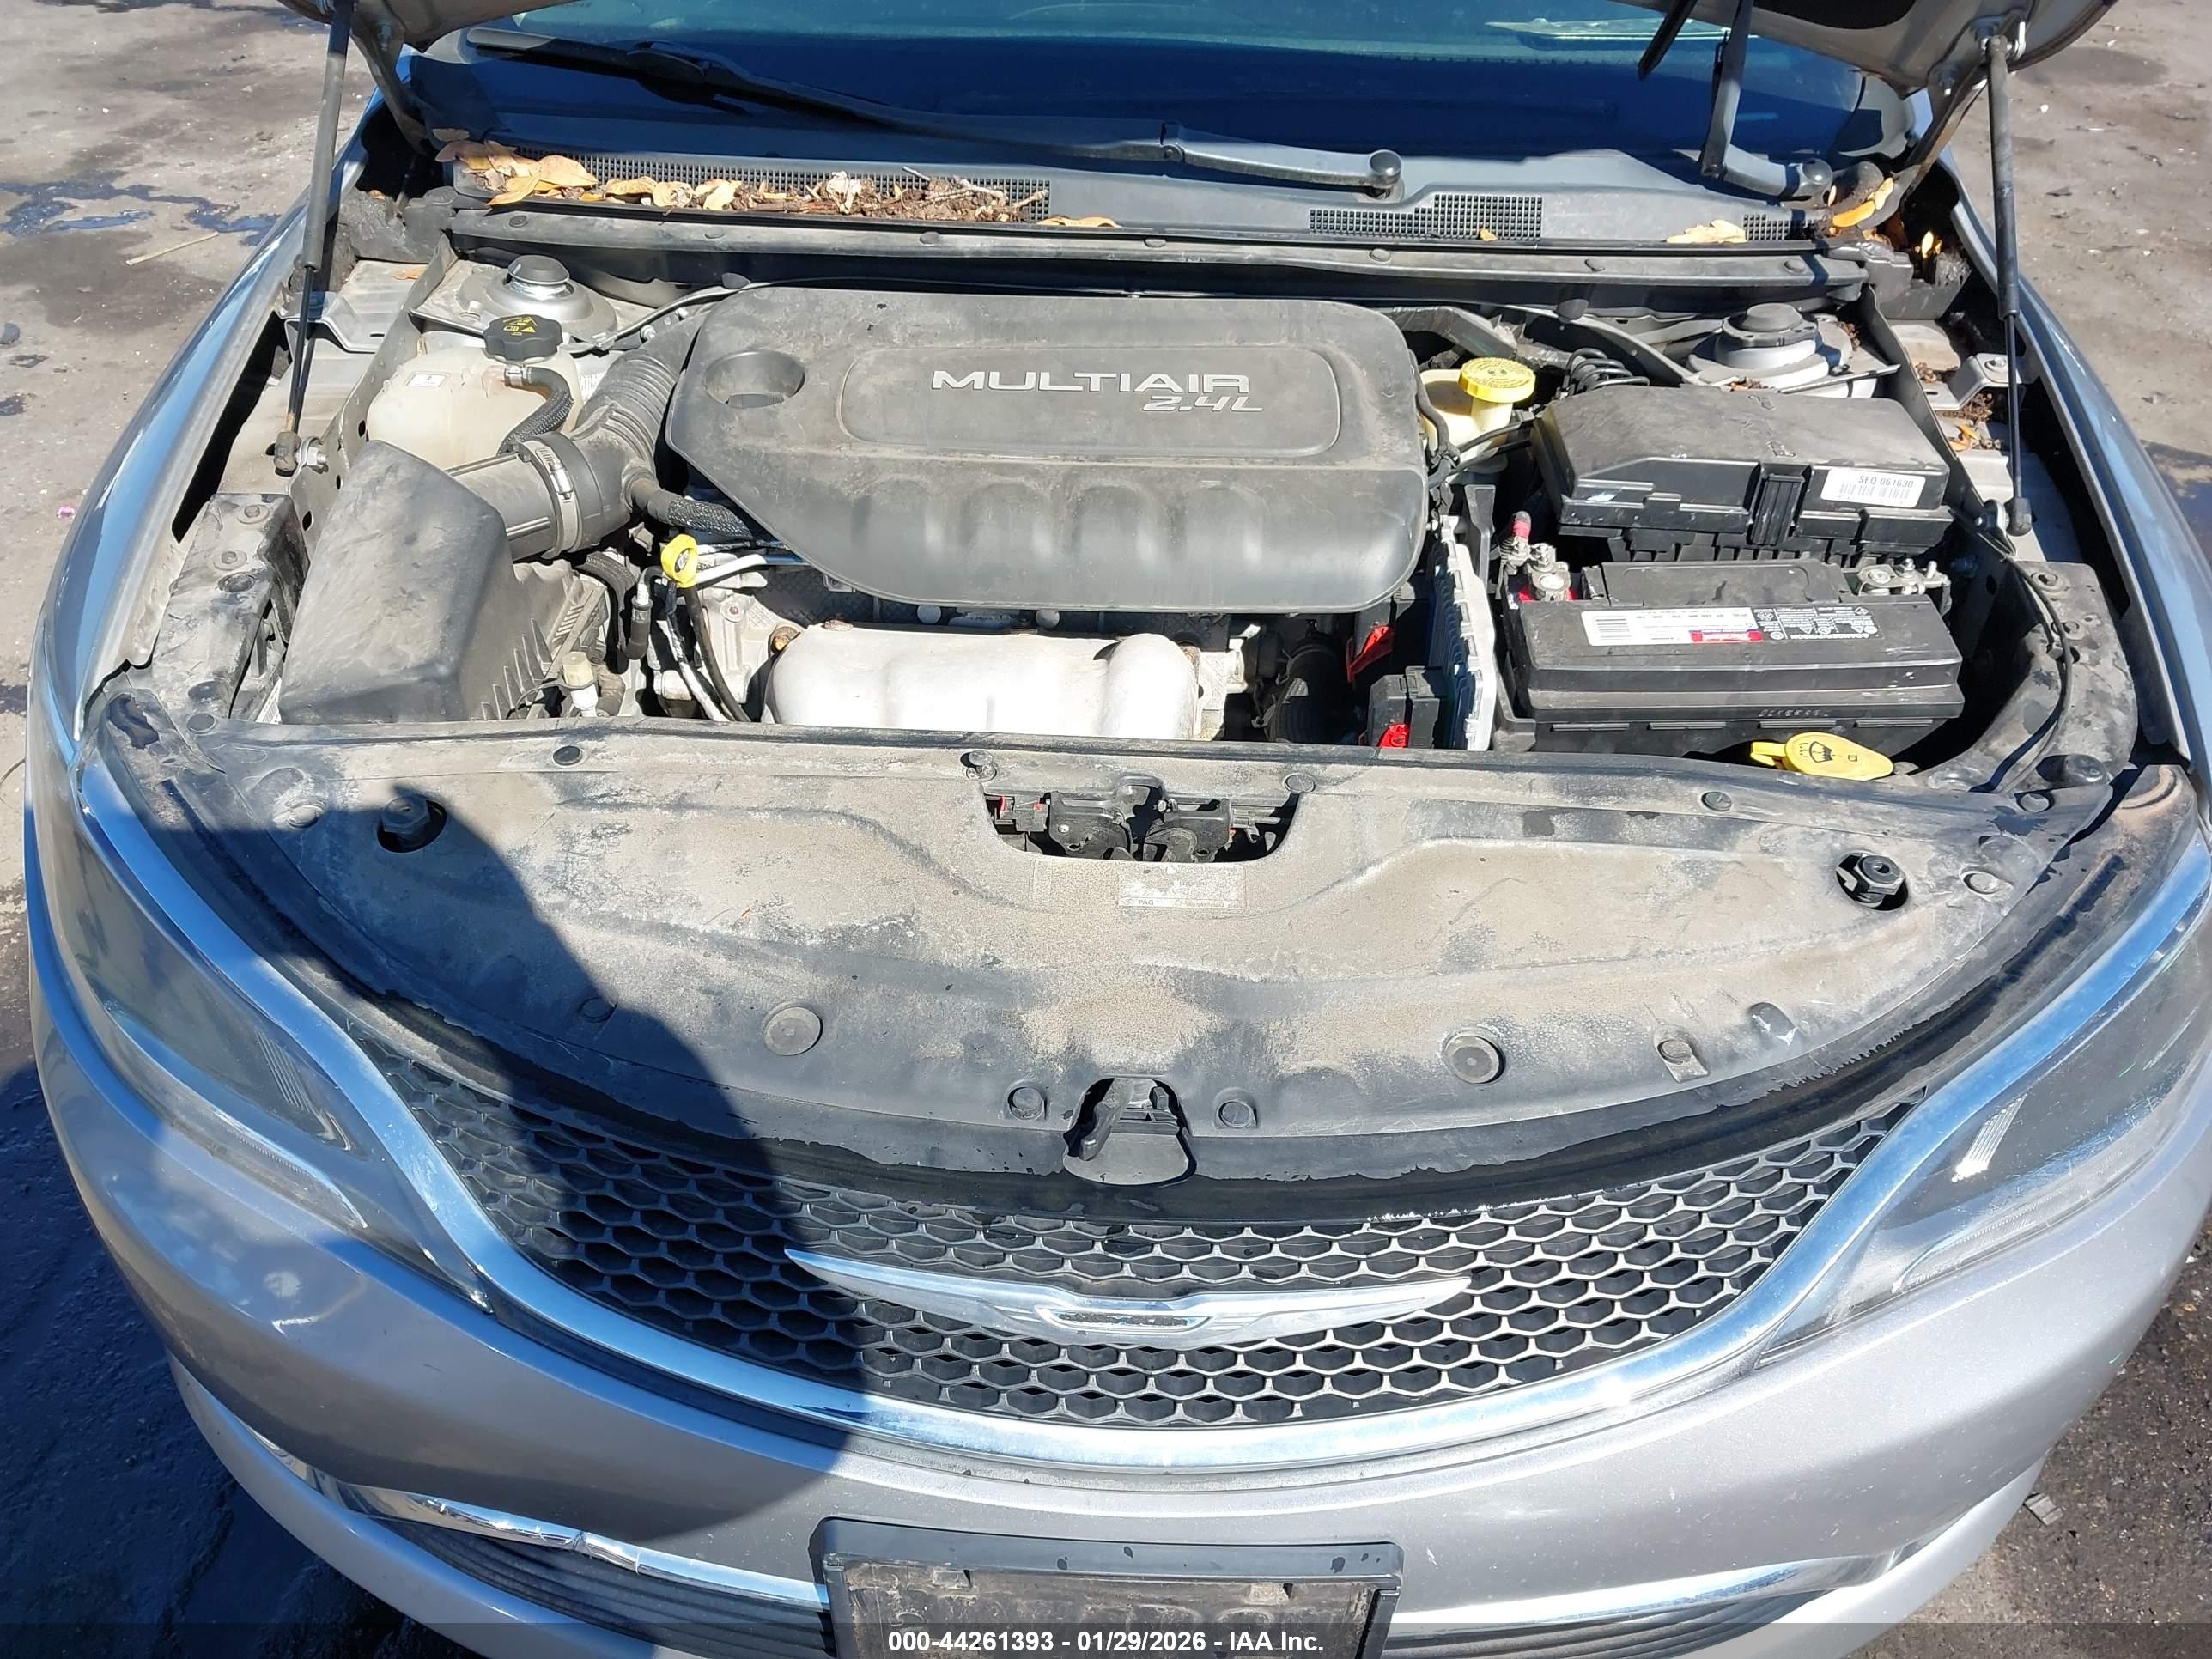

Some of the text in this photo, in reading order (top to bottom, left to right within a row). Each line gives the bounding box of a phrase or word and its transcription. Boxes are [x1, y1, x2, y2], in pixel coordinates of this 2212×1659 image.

[931, 370, 1250, 393] MULTIAIR
[1142, 396, 1264, 412] 2.4L
[1858, 475, 1877, 485] SEQ
